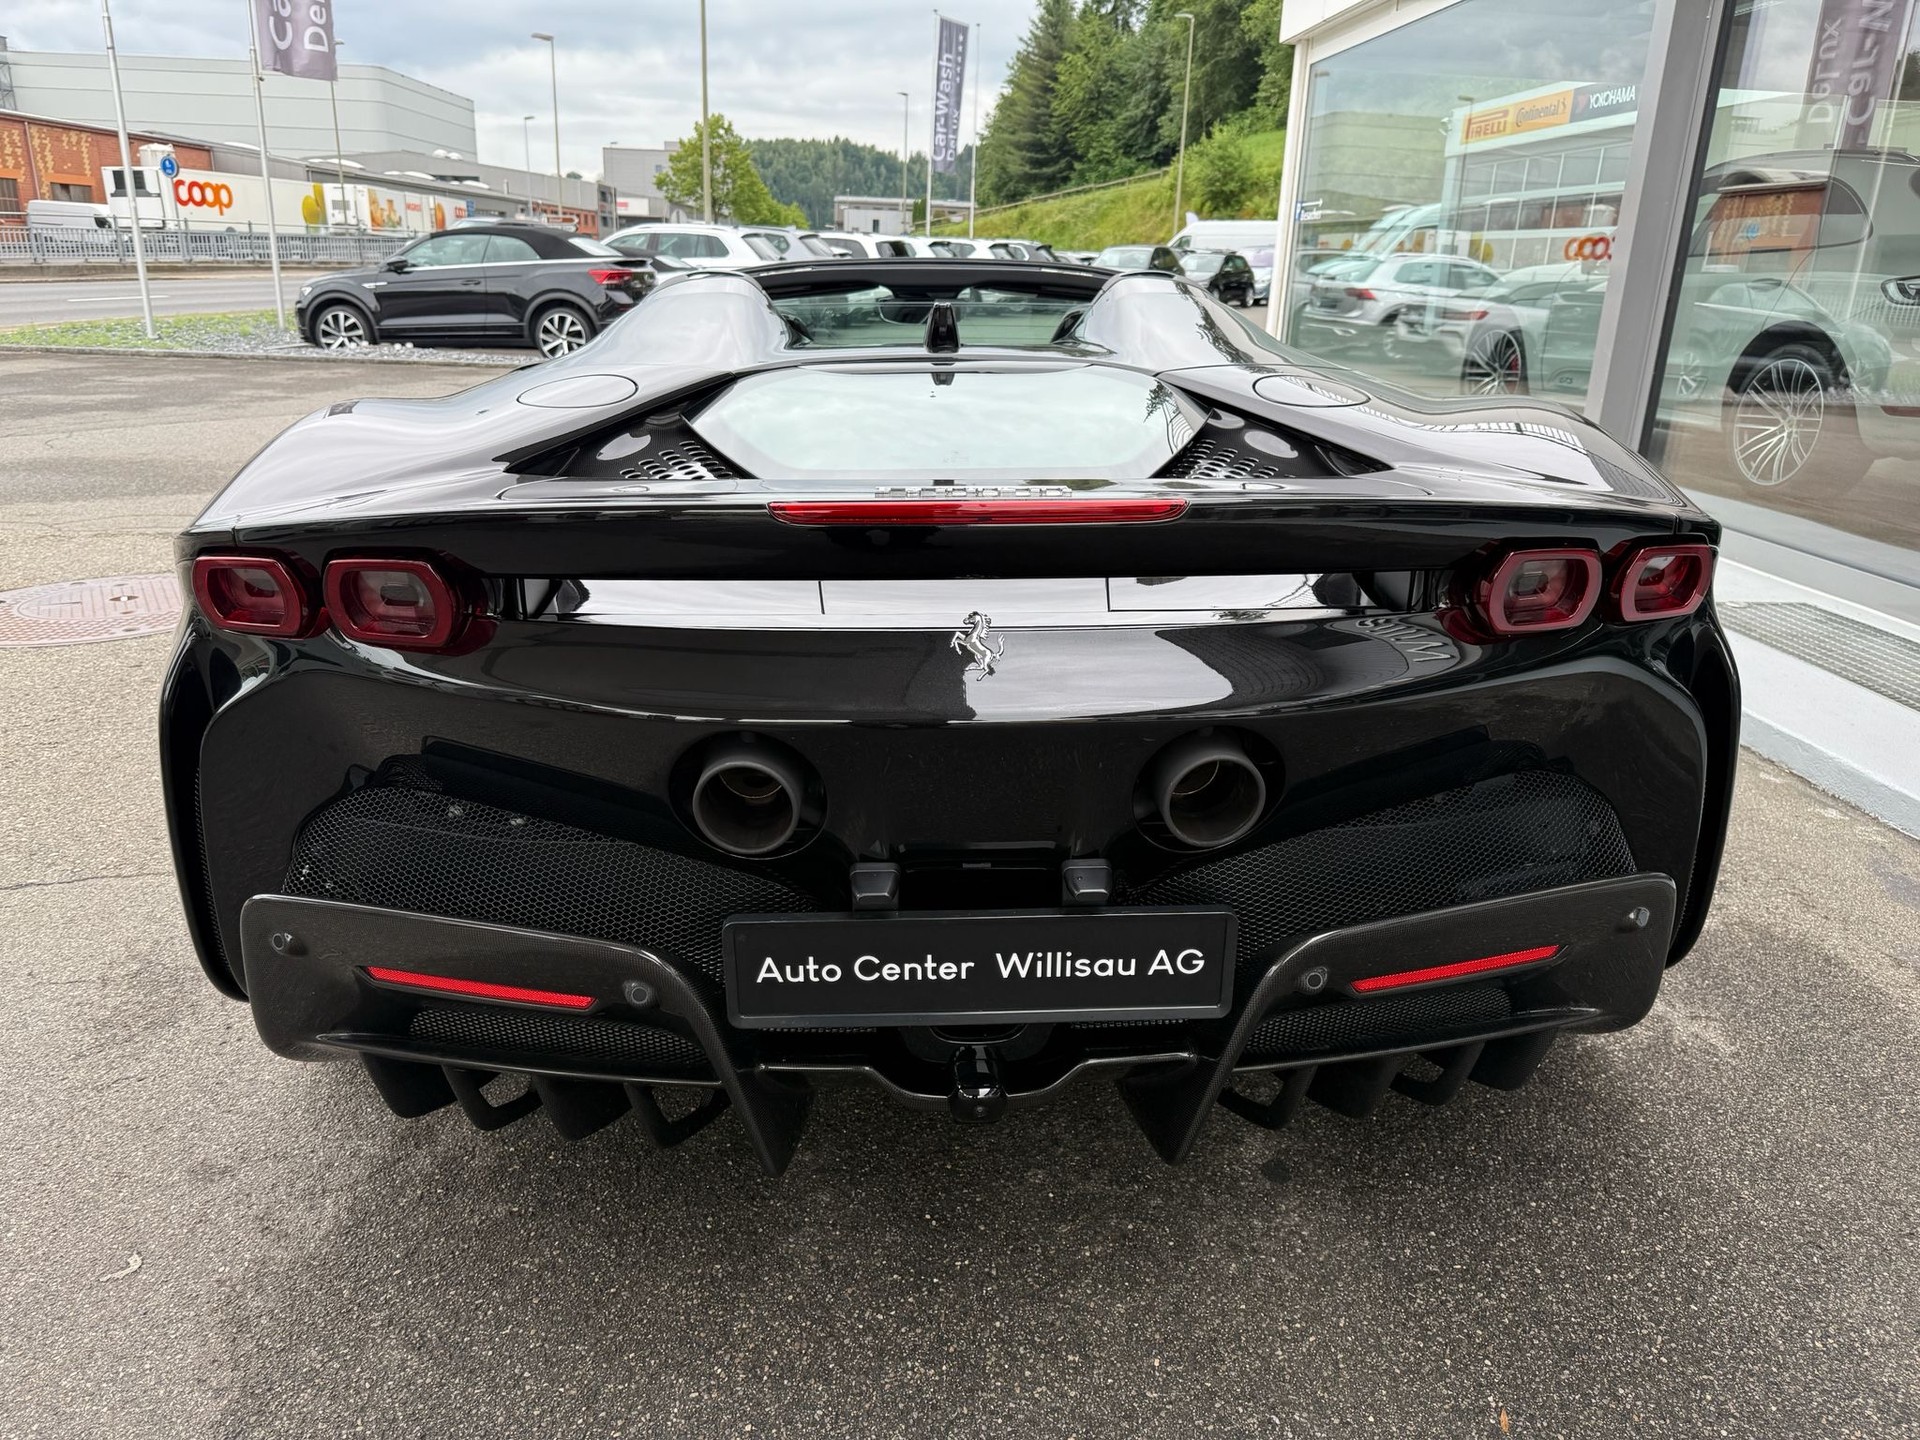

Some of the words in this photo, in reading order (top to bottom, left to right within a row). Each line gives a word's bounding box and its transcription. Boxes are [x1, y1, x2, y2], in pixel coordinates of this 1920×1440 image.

[932, 53, 954, 161] Car-Wash
[1515, 99, 1560, 128] Continental
[1589, 85, 1637, 109] YOKOHAMA
[1465, 109, 1510, 141] PIRELLI
[173, 179, 234, 216] coop
[756, 956, 842, 984] Auto
[853, 954, 975, 982] Center
[995, 950, 1136, 979] Willisau
[1147, 948, 1205, 977] AG
